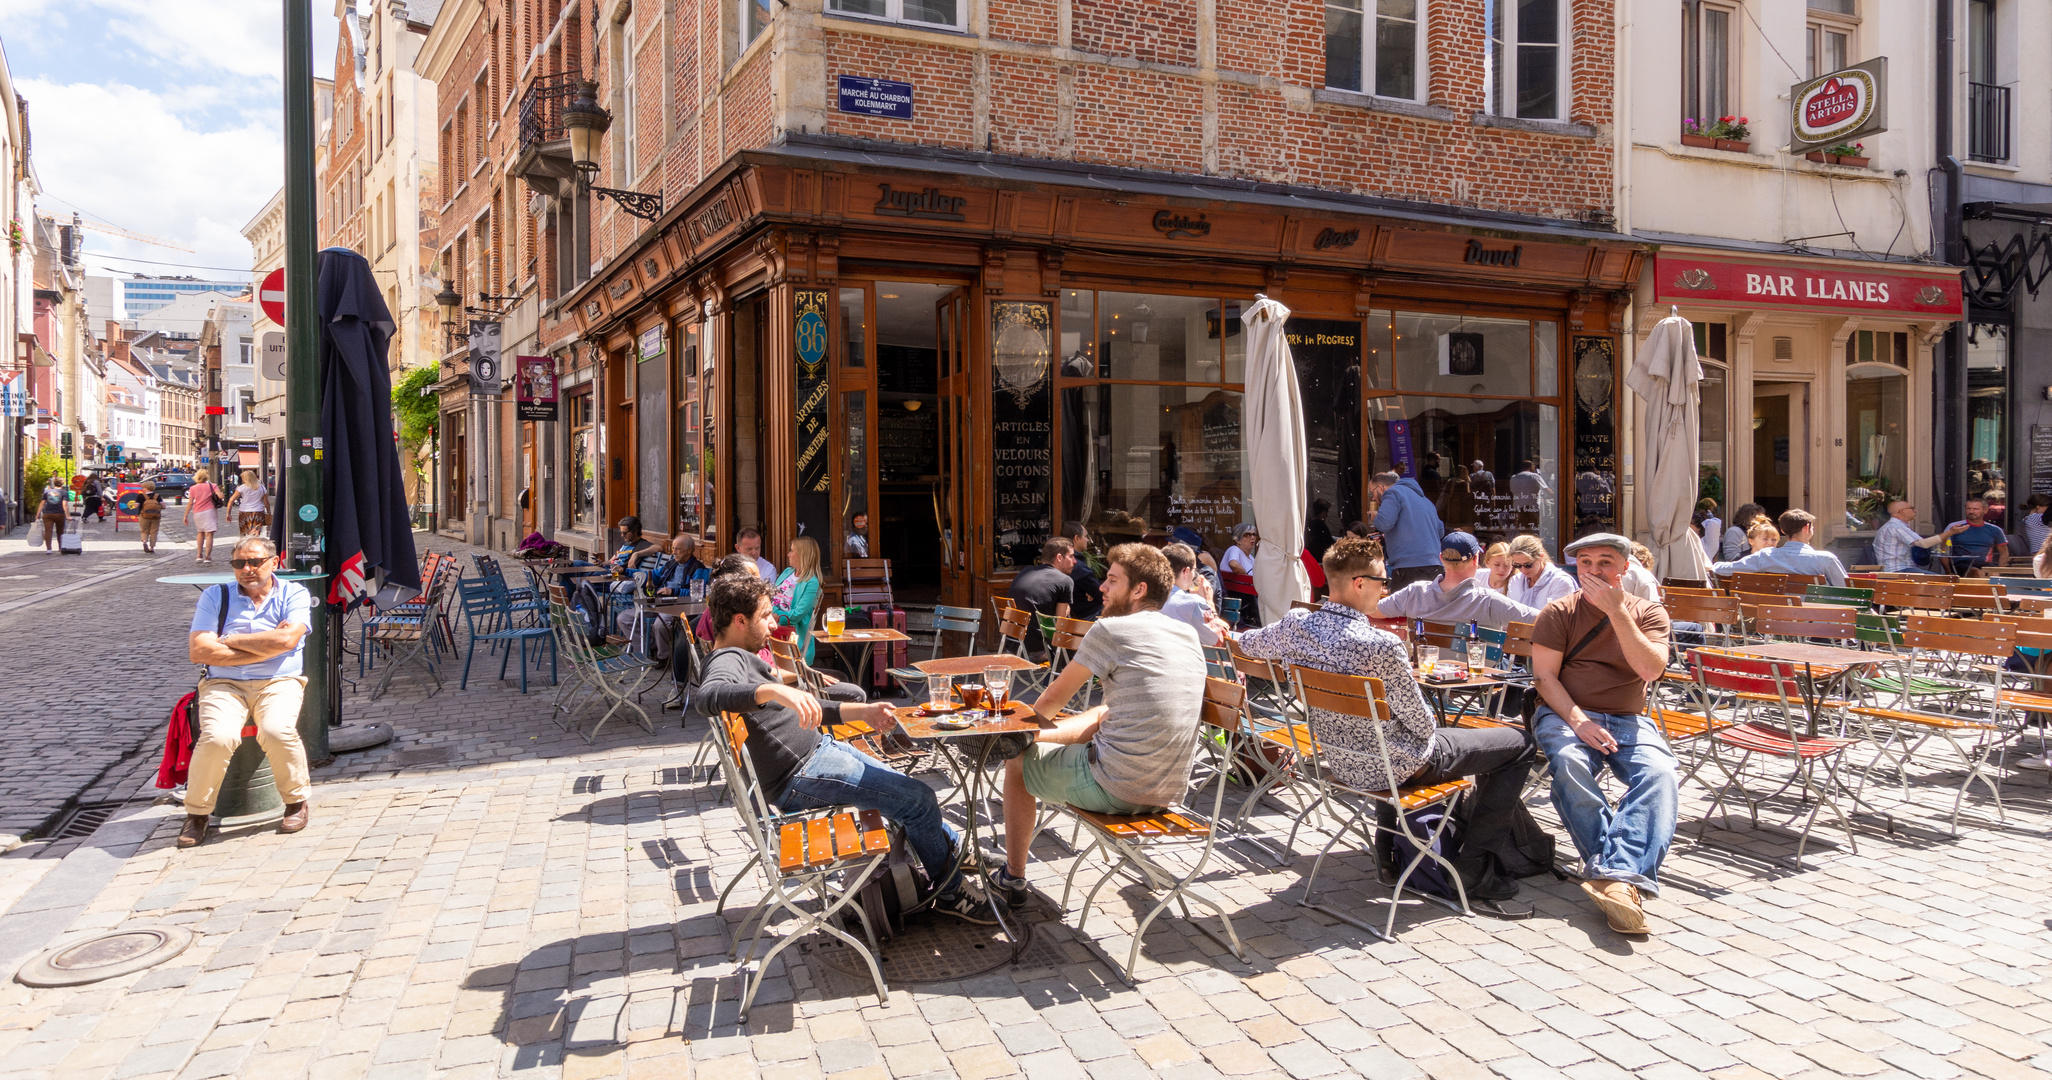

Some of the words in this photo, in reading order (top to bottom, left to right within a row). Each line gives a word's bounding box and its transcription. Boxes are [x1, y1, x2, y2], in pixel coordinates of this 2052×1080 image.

[841, 88, 868, 98] MARCHÉ
[880, 93, 910, 103] CHARBON
[1809, 92, 1854, 112] STELLA
[855, 99, 897, 110] KOLENMARKT
[1809, 101, 1855, 121] ARTOIS
[875, 183, 967, 216] Jupiler
[688, 220, 701, 247] AU
[700, 199, 733, 238] SOLEIL
[1153, 209, 1211, 236] Carlsberg
[1464, 239, 1523, 267] Duvel
[1746, 273, 1796, 297] BAR
[1805, 277, 1890, 303] LLANES
[798, 320, 825, 353] 86
[1284, 333, 1302, 345] ORK
[1305, 335, 1315, 346] in
[1316, 333, 1355, 346] PROGRESS
[796, 379, 830, 425] ARTICLES
[806, 417, 819, 434] DE
[995, 421, 1050, 432] ARTICLES
[1016, 436, 1030, 445] EN
[1580, 434, 1609, 443] VENTE
[1835, 438, 1842, 447] 88
[796, 426, 830, 472] BONNETERIE
[995, 449, 1050, 461] VELOURS
[1589, 446, 1600, 454] DE
[1598, 457, 1614, 467] LES
[996, 465, 1050, 477] COTONS
[1016, 480, 1030, 489] ET
[1001, 492, 1046, 504] BASIN
[954, 898, 975, 915] N
